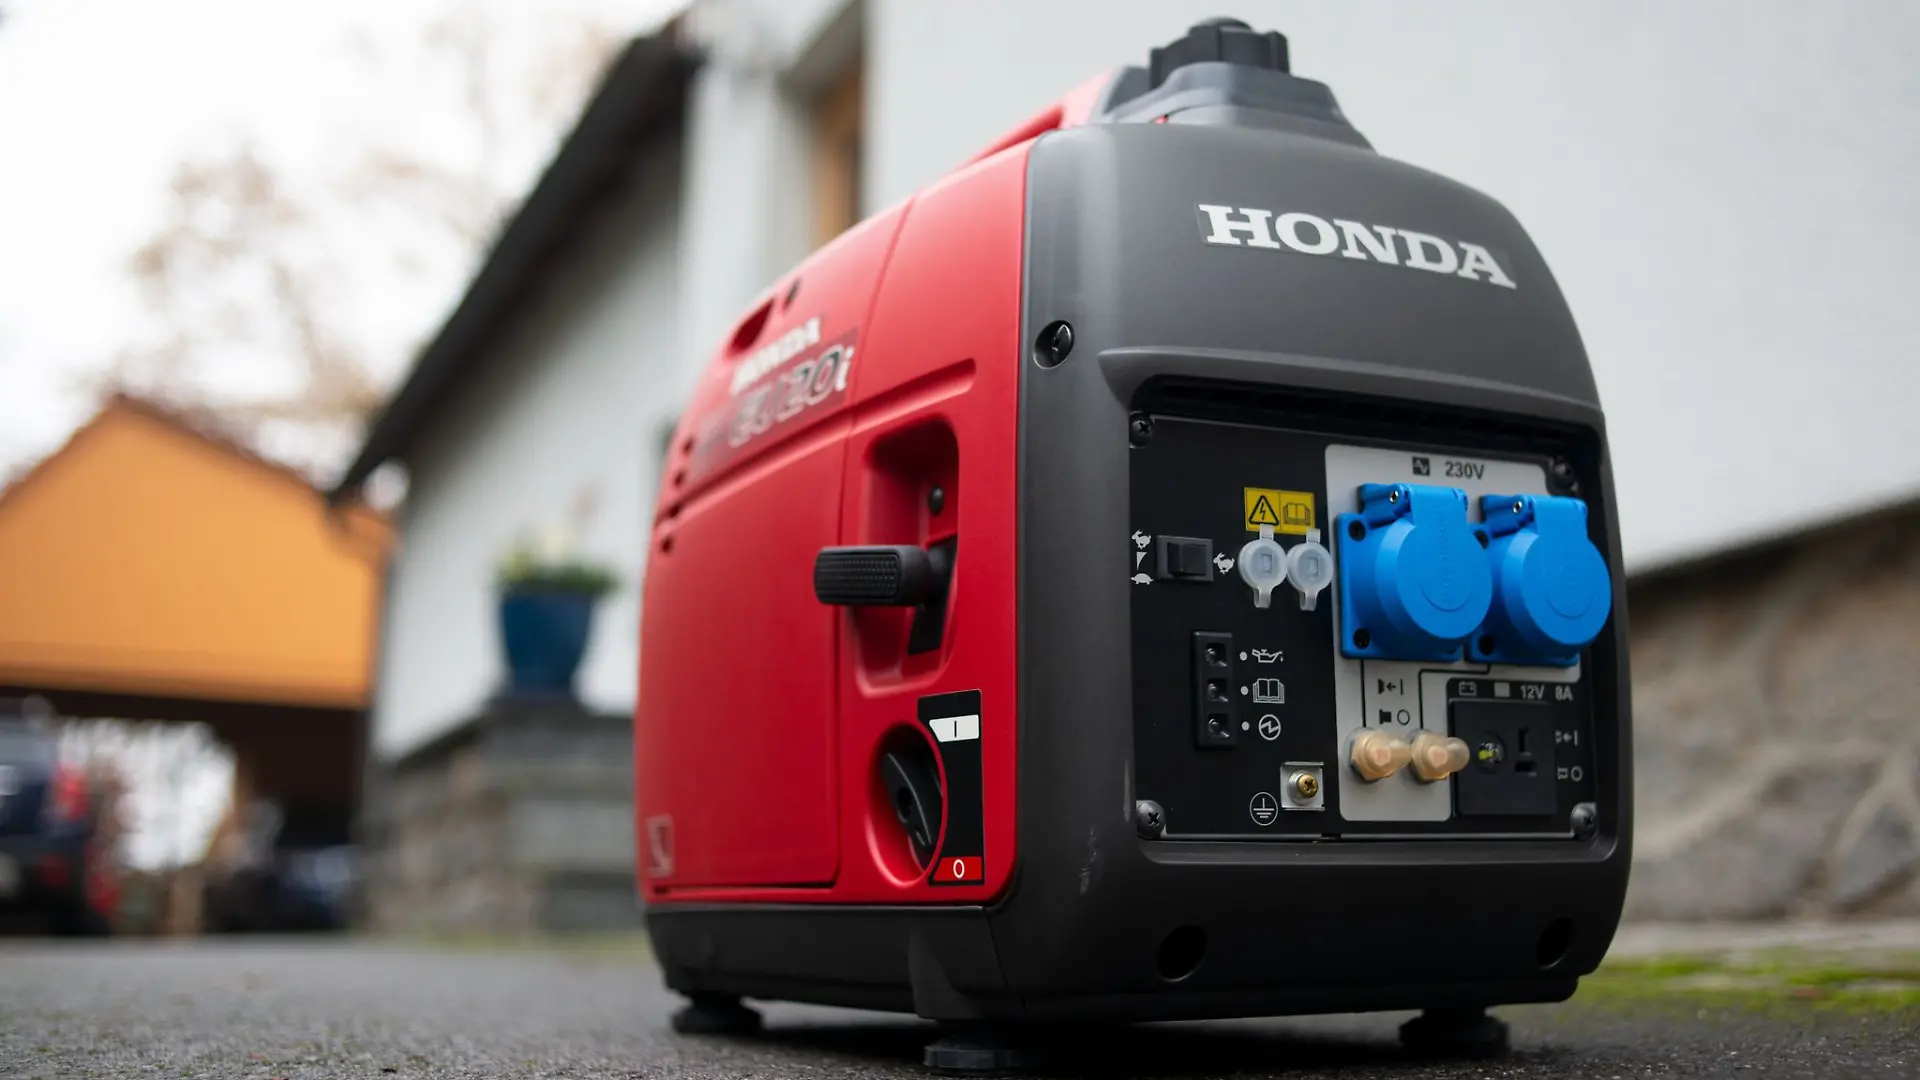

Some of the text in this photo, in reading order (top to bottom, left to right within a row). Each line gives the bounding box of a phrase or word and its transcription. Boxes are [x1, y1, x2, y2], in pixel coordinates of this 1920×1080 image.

[1198, 204, 1517, 289] HONDA
[1444, 460, 1485, 480] 230V
[1520, 684, 1573, 701] 12V 8A
